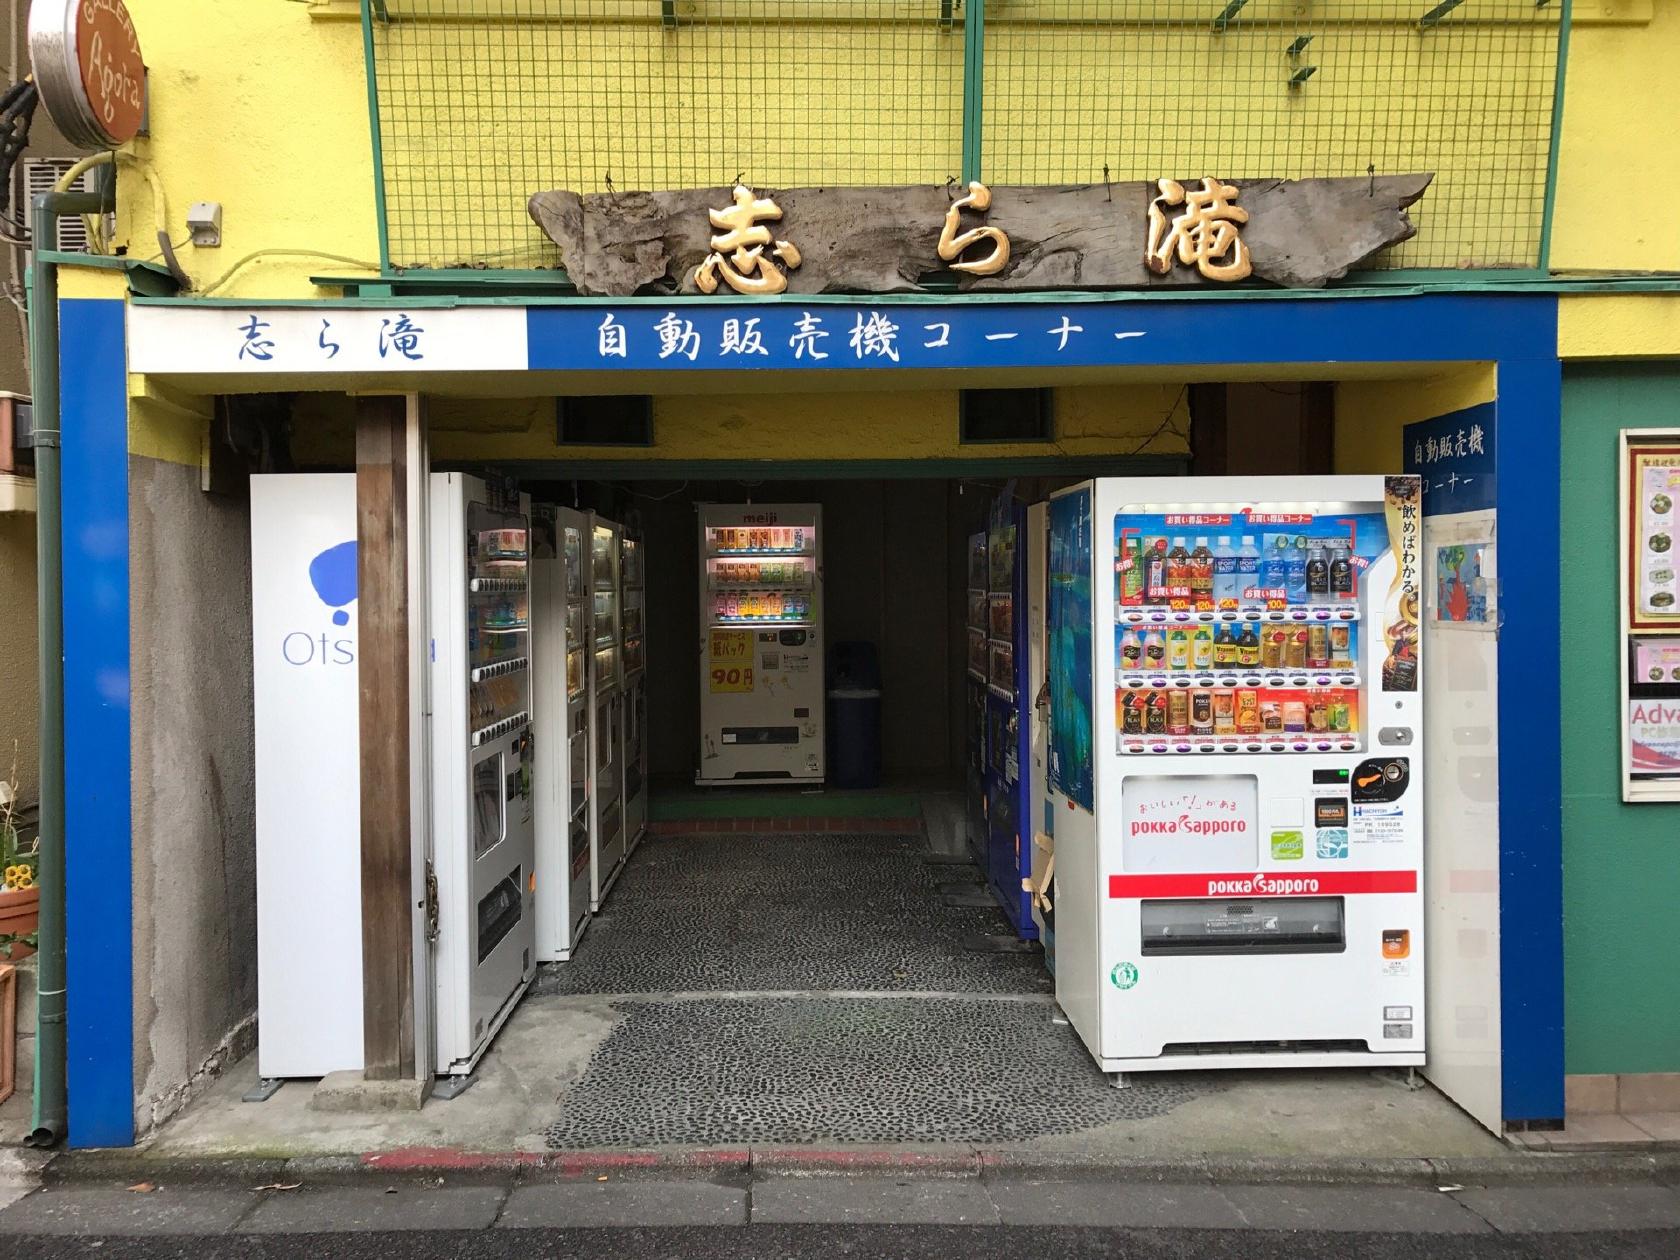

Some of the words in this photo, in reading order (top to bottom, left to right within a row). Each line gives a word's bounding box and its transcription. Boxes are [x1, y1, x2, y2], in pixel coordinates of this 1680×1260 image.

[88, 31, 141, 123] Agora
[693, 176, 1253, 295] 志ら滝
[238, 314, 425, 361] 志ら滝
[597, 310, 1147, 362] 自動販売機コーナー
[1413, 424, 1485, 465] 自動販売機
[743, 512, 777, 525] meiji
[1248, 514, 1312, 523] お買い得品コーナー
[282, 632, 354, 666] Ots
[711, 668, 753, 685] 90円
